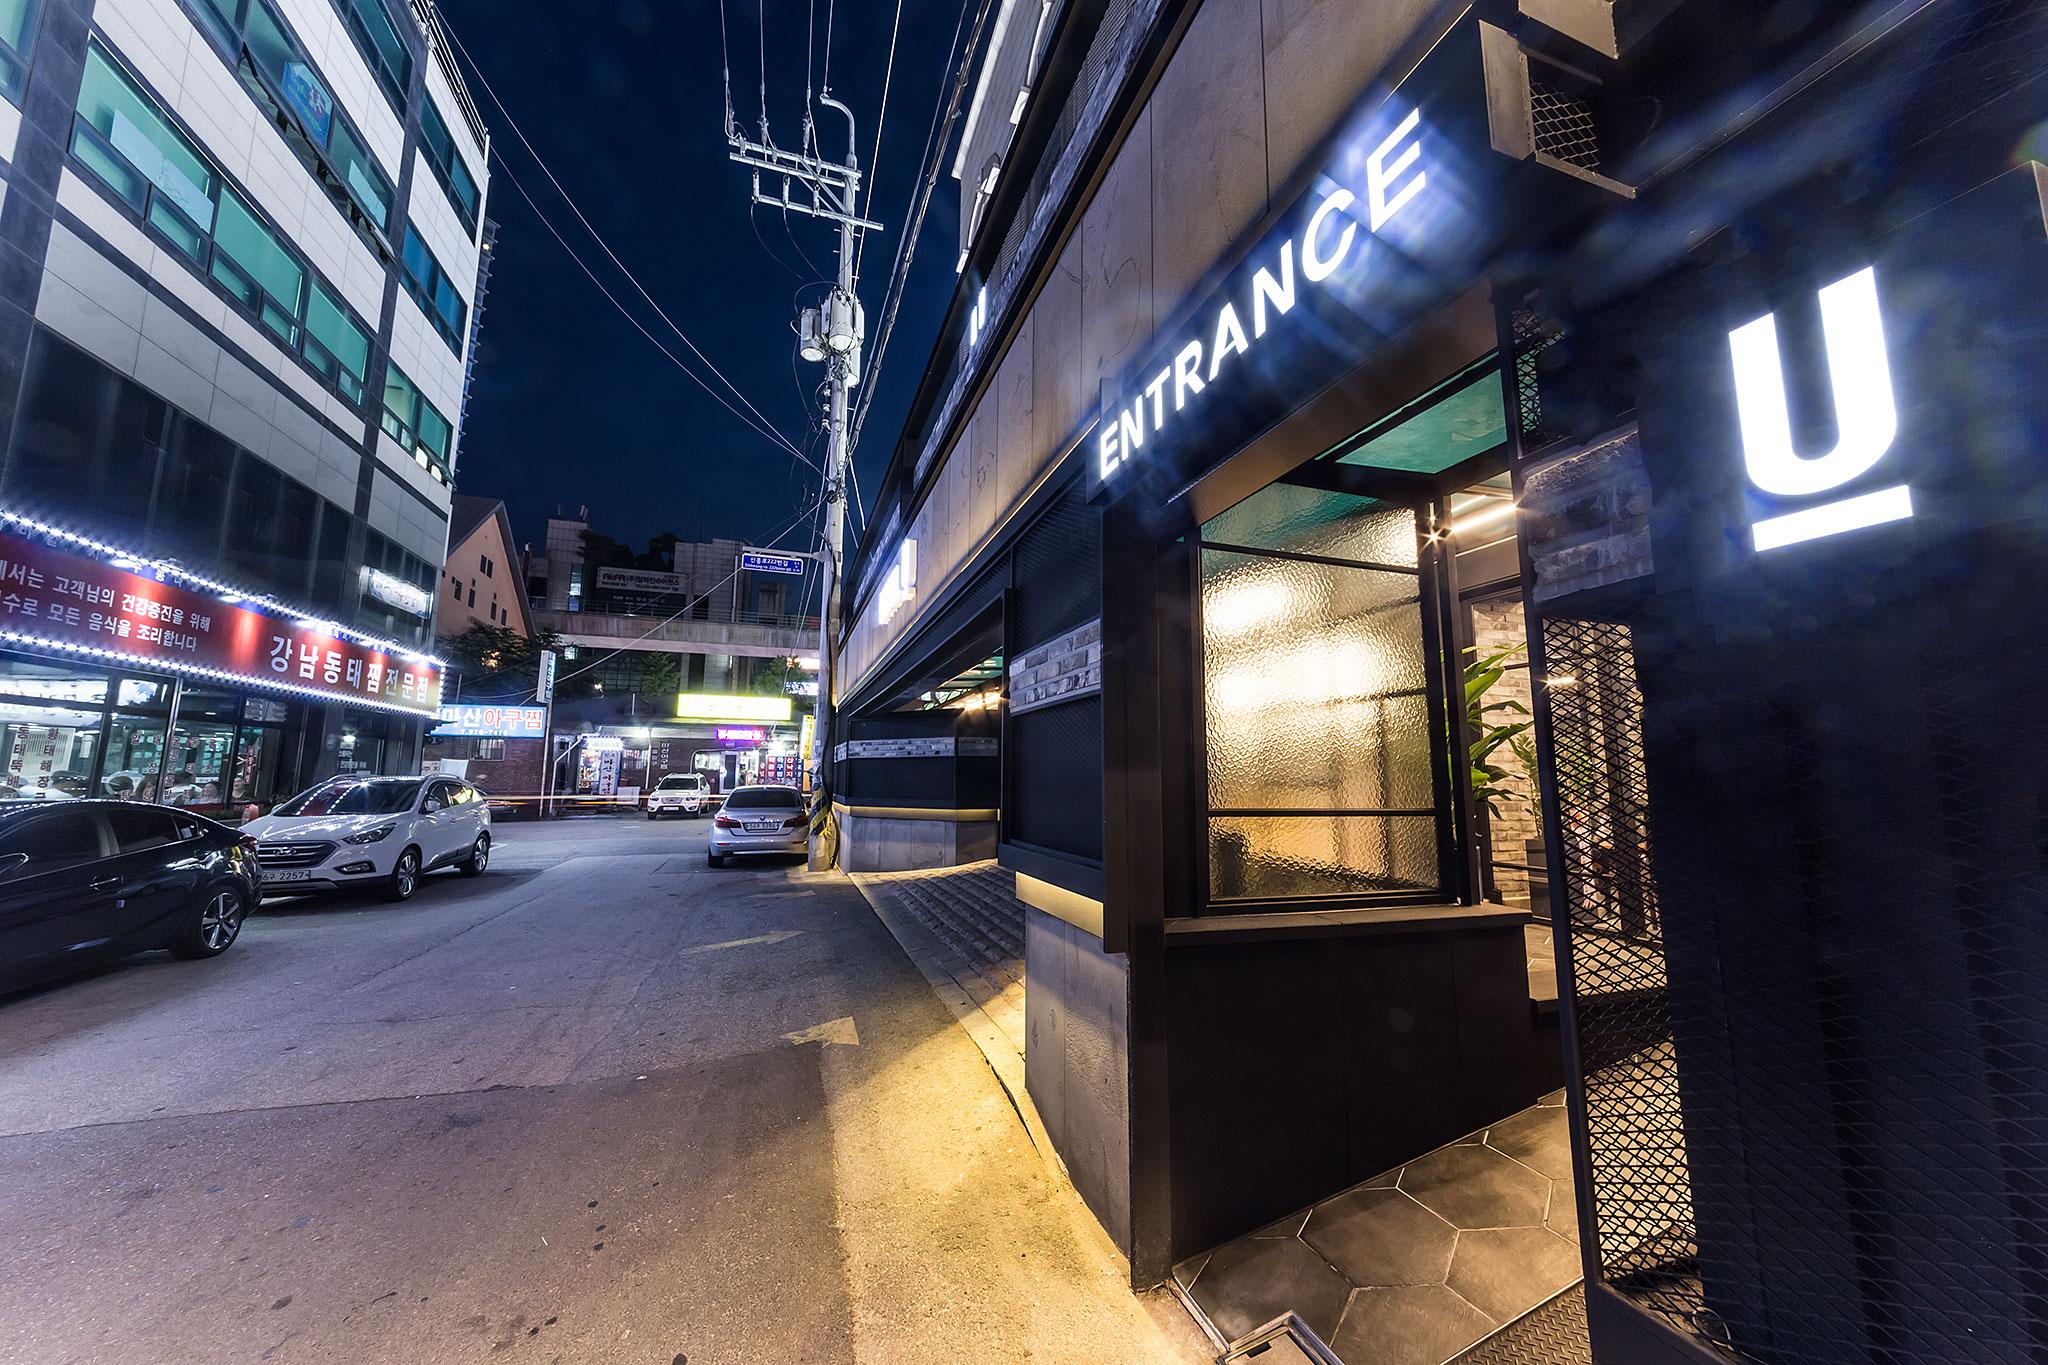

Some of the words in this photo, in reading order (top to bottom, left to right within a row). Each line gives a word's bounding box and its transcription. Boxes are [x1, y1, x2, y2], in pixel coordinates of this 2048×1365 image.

[1100, 108, 1427, 481] ENTRANCE
[1729, 266, 1898, 497] U
[750, 557, 789, 567] 신흥로222번길
[0, 590, 39, 618] 수로
[48, 602, 80, 626] 모든
[89, 611, 132, 637] 음식을
[136, 623, 198, 652] 조리합니다
[52, 575, 116, 608] 고객님의
[122, 593, 184, 625] 건강증진을
[189, 612, 211, 632] 위해
[440, 706, 543, 730] 마산아구찜
